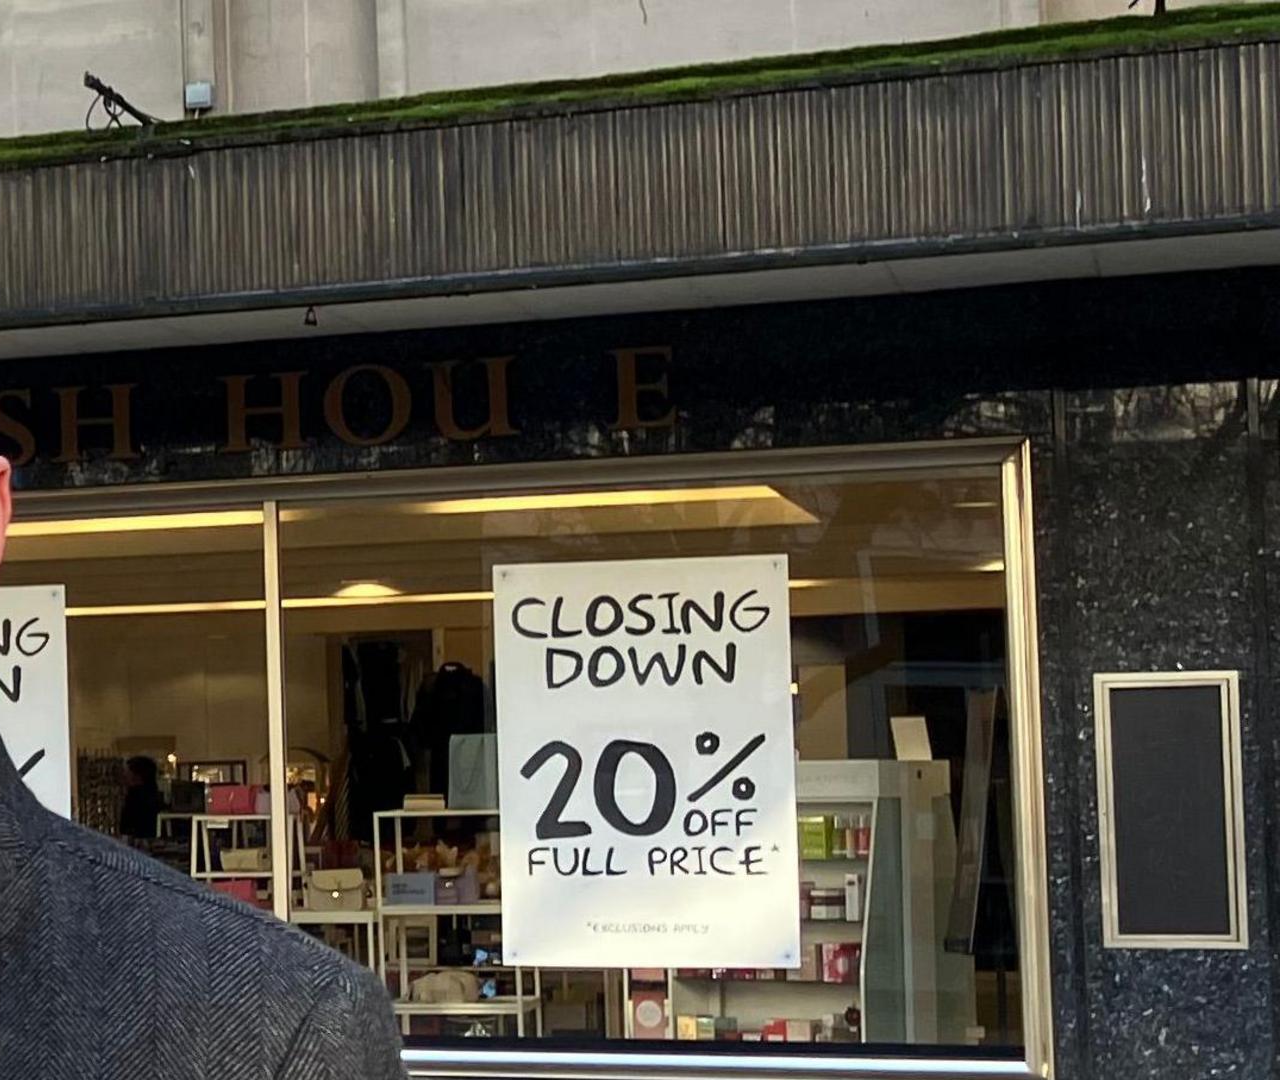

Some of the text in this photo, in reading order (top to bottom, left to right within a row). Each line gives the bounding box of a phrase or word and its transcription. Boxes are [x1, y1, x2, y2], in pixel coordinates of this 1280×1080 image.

[511, 589, 770, 638] CLOSING
[546, 642, 737, 689] DOWN
[520, 731, 766, 840] 20%
[683, 808, 758, 837] OFF
[528, 847, 627, 876] FULL
